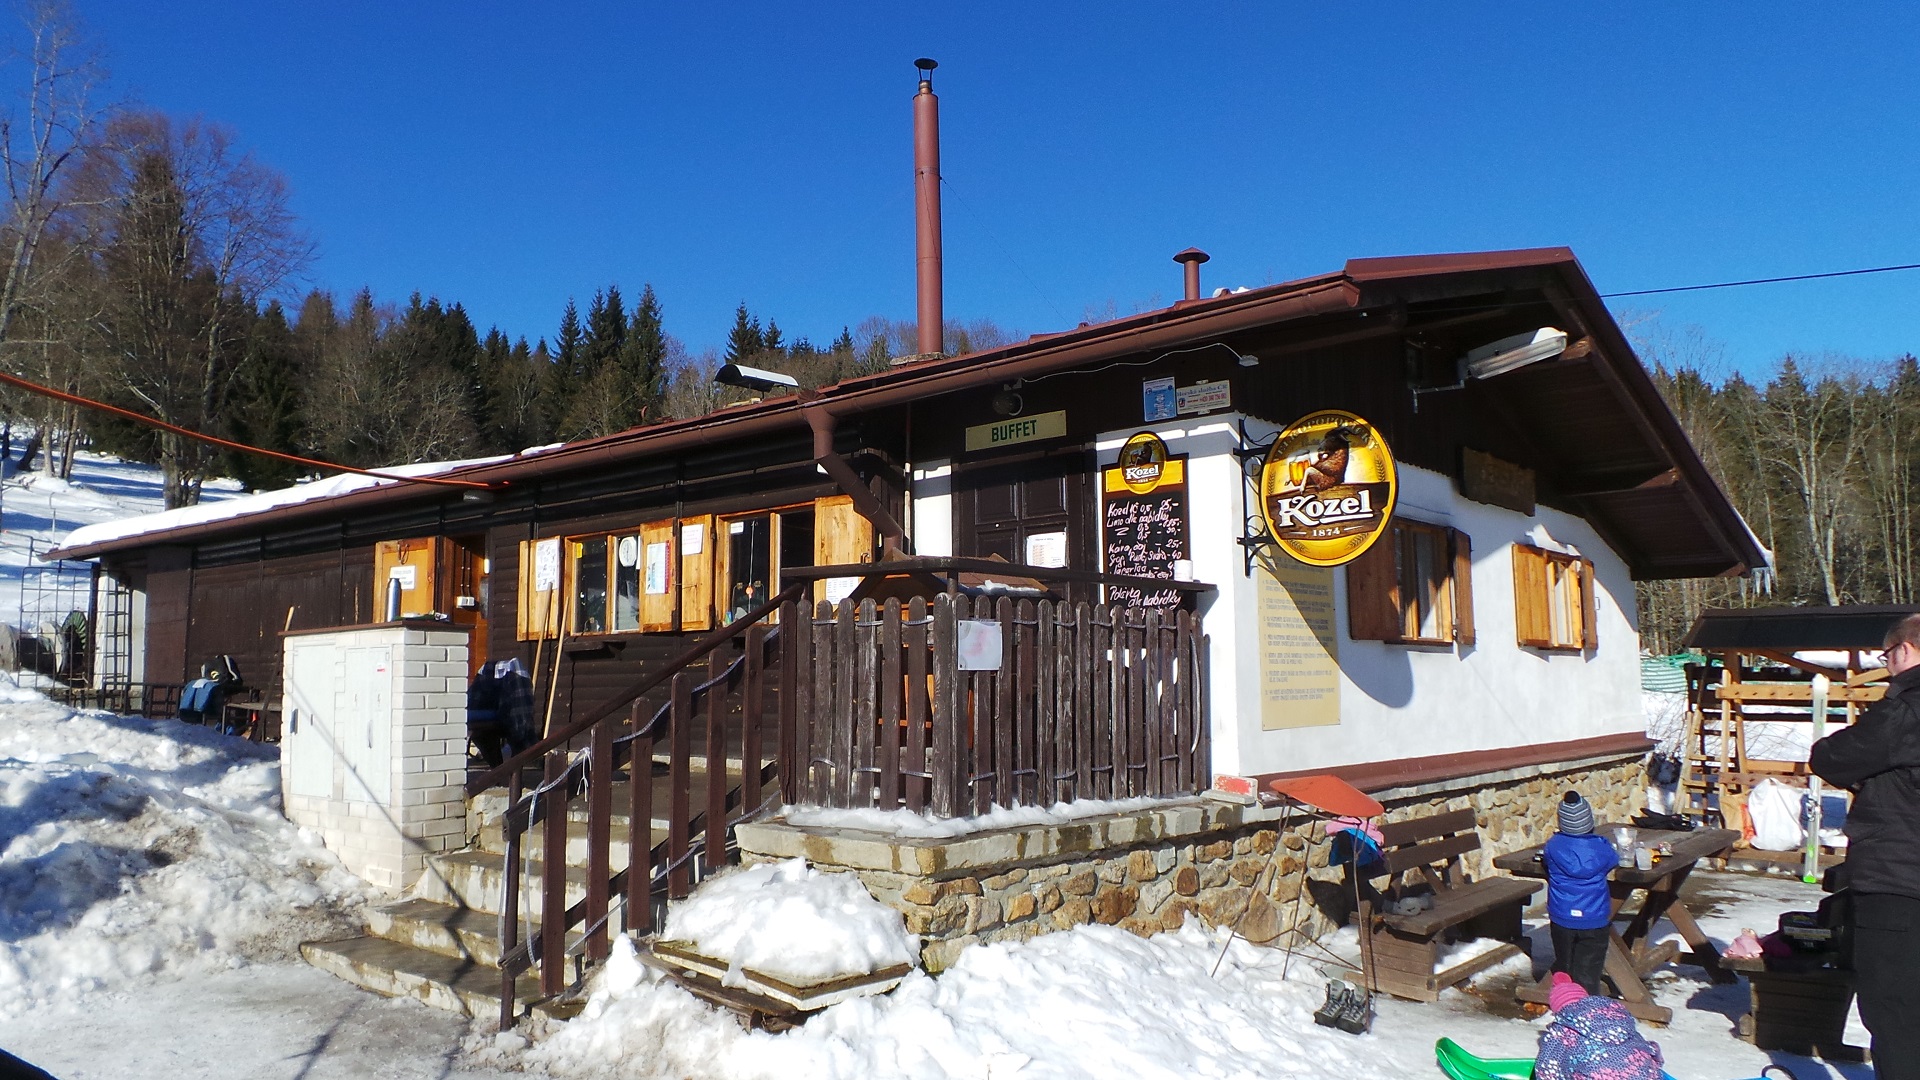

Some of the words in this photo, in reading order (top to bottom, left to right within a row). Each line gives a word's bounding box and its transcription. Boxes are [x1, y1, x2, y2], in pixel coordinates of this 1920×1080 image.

[991, 419, 1037, 443] BUFFET
[1125, 464, 1159, 479] Kozel
[1277, 489, 1374, 527] Kozel
[1312, 527, 1341, 537] 1874
